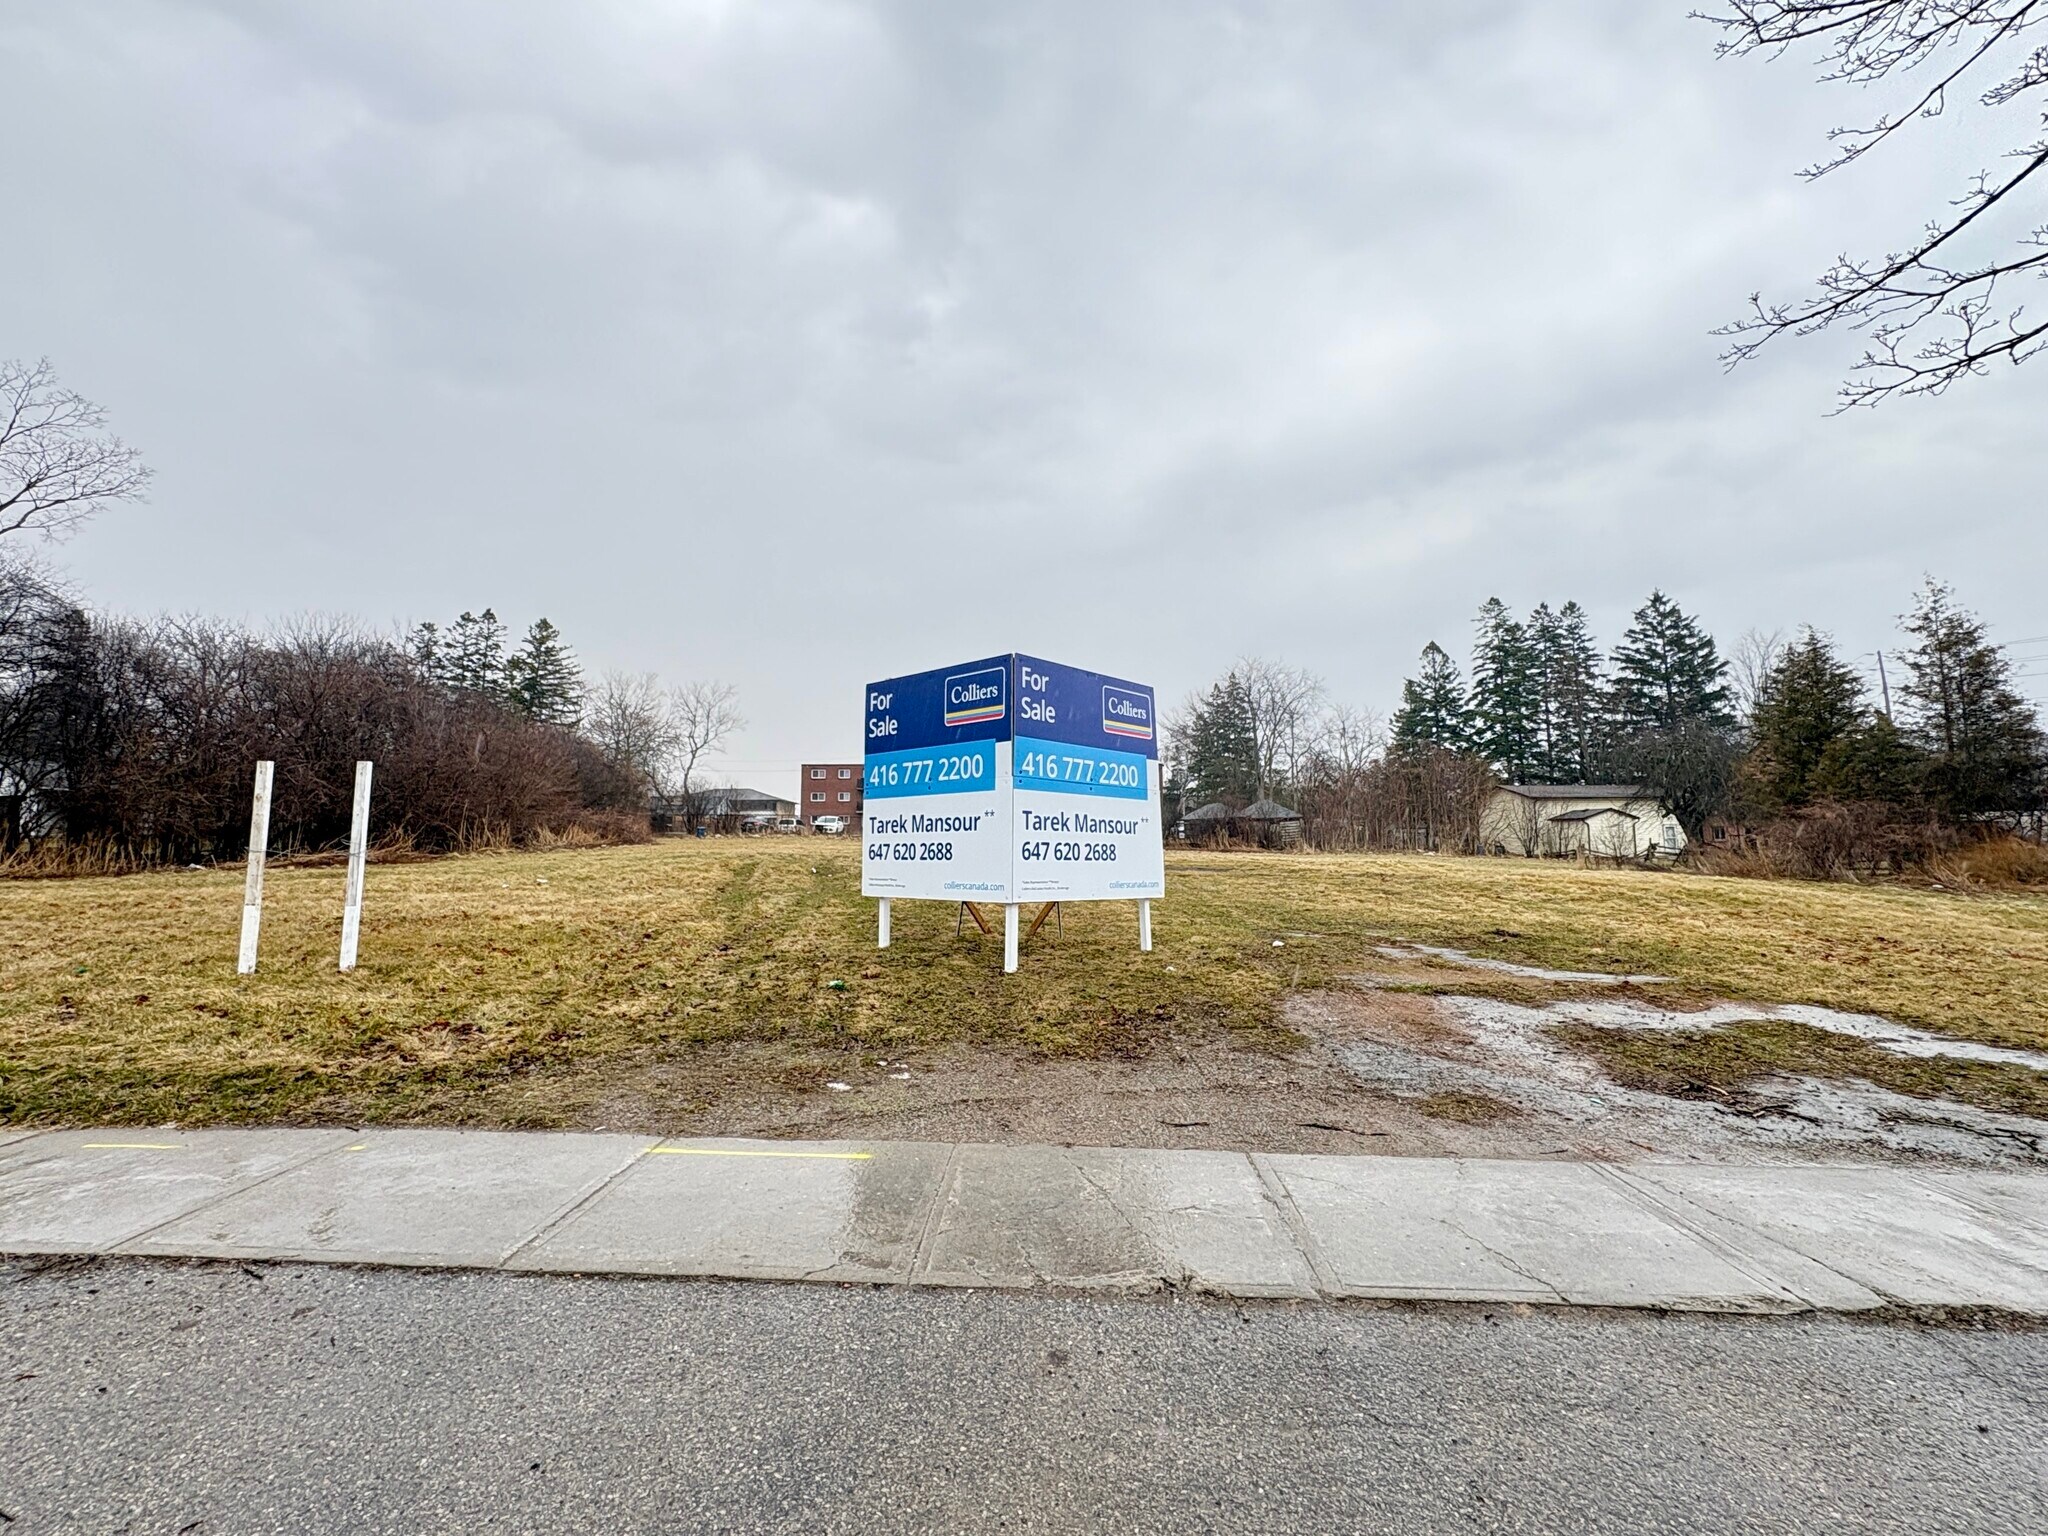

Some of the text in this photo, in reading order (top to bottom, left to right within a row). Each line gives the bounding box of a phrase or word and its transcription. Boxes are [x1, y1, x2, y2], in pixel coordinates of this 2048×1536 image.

[1021, 667, 1050, 693] For
[870, 692, 892, 712] For
[951, 684, 998, 704] Colliers
[1021, 697, 1056, 723] Sale
[1108, 697, 1147, 720] Colliers
[869, 716, 898, 738] Sale
[869, 754, 984, 787] 416 777 2200
[1022, 752, 1138, 787] 416 777 2200
[869, 813, 980, 834] Tarek Mansour
[1022, 810, 1138, 835] Tarek Mansour
[868, 842, 953, 861] 647 620 2688
[1021, 842, 1117, 861] 647 620 2688
[943, 881, 1005, 892] collierscanada.com
